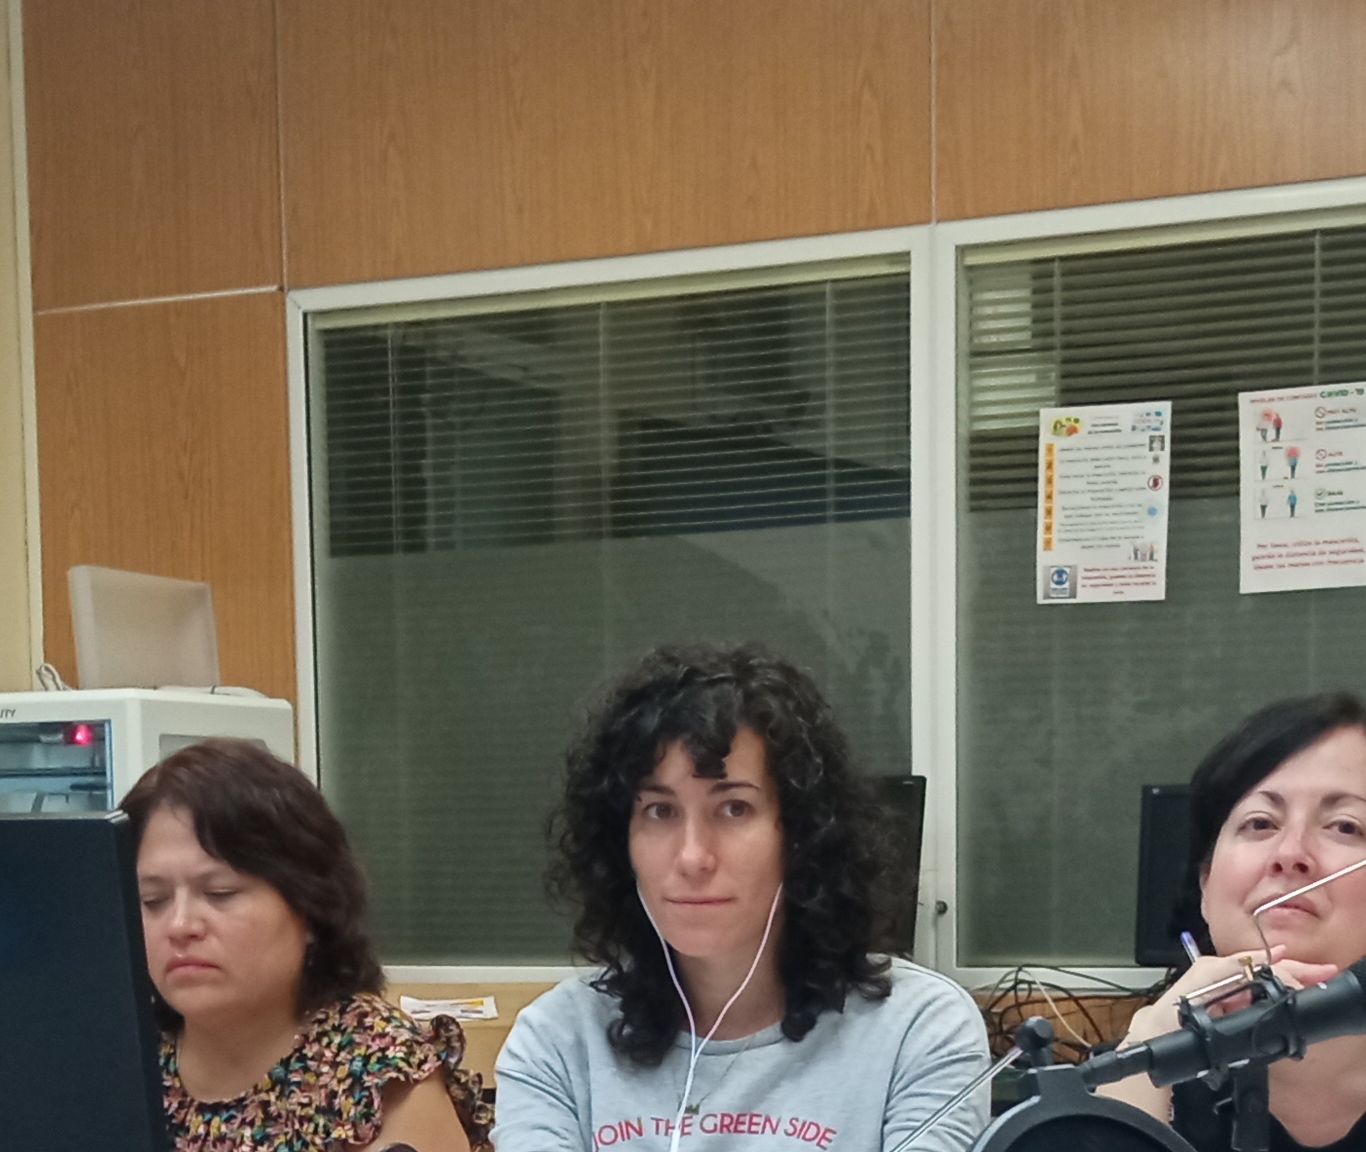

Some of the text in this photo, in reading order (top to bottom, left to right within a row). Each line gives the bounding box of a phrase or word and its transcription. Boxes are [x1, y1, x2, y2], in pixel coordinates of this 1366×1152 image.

[650, 1112, 694, 1137] THE
[699, 1112, 783, 1136] GREEN
[784, 1116, 838, 1151] SIDE
